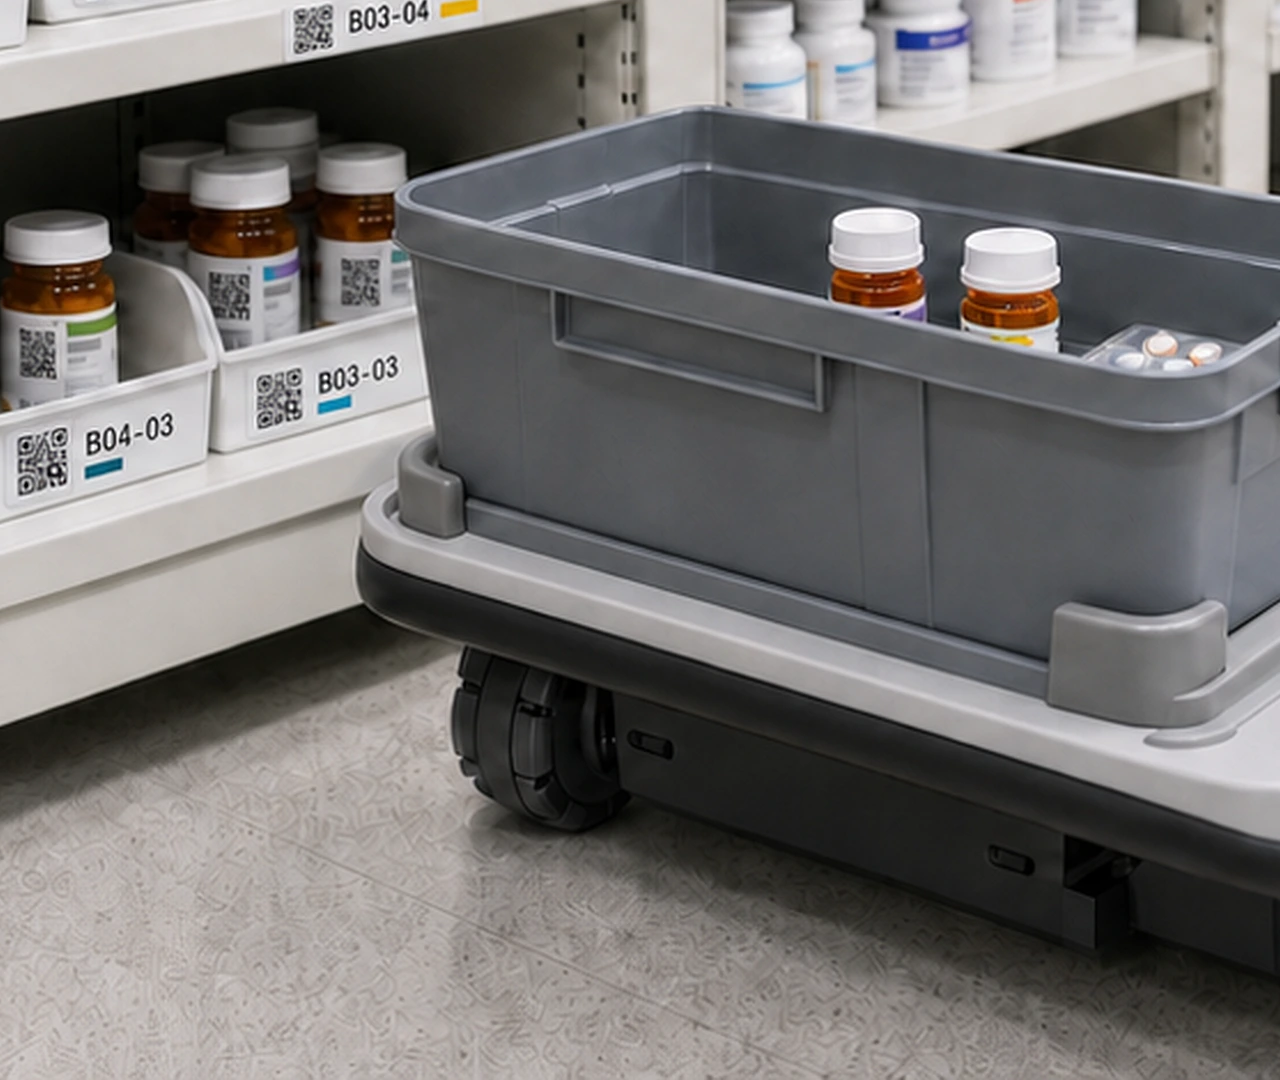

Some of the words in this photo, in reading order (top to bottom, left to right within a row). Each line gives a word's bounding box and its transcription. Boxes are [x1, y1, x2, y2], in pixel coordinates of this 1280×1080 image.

[349, 0, 430, 34] B03-04
[318, 355, 399, 395] B03-03
[86, 412, 174, 457] B04-03
